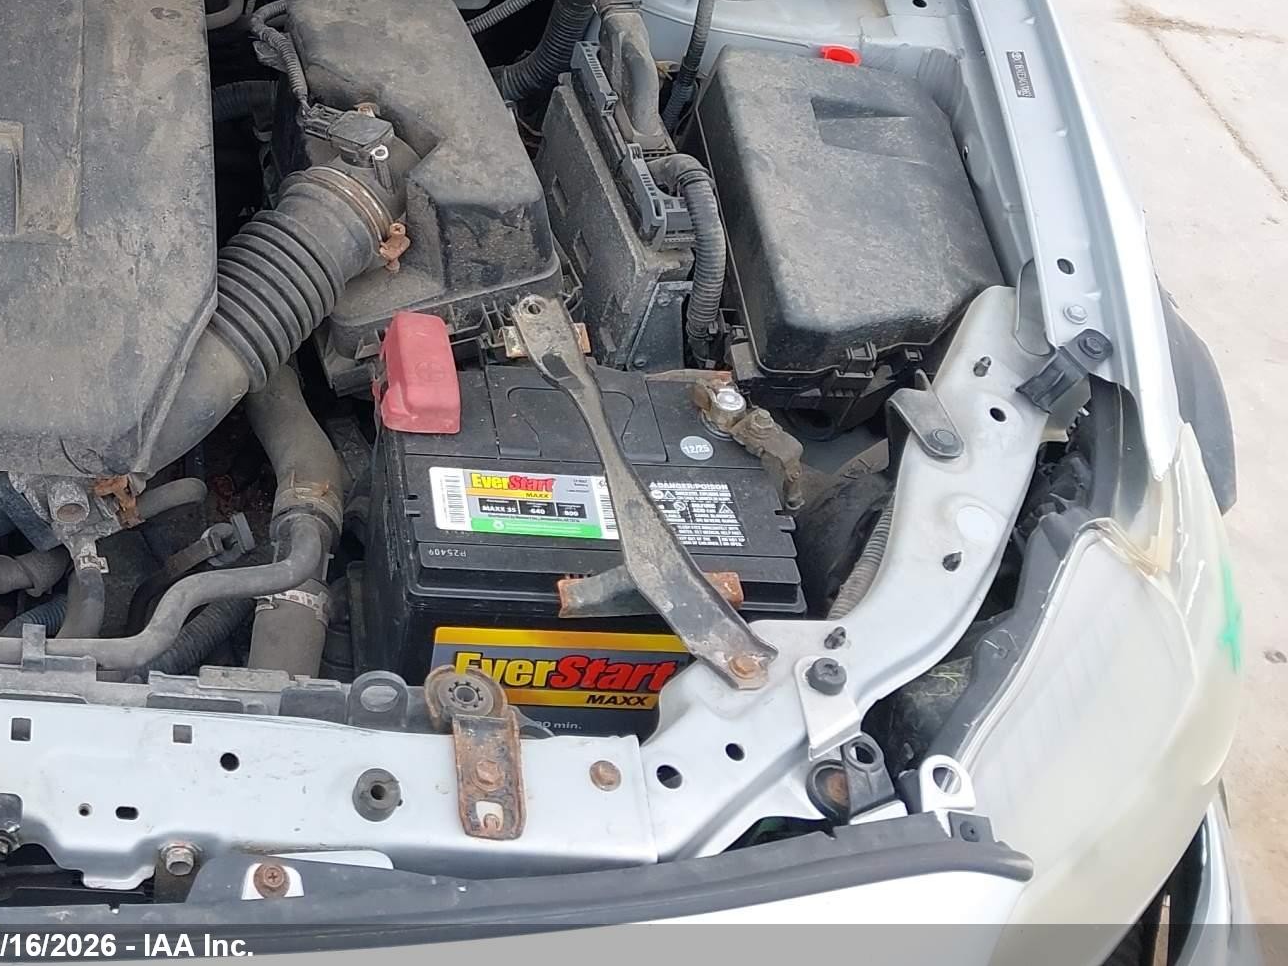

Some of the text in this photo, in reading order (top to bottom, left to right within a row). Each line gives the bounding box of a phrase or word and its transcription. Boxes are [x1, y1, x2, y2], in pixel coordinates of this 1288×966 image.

[684, 444, 710, 454] 12/25
[470, 473, 556, 491] EverStart
[428, 547, 467, 557] P25409
[455, 650, 676, 692] EverStart
[585, 694, 649, 707] MAXX
[553, 721, 582, 729] min.
